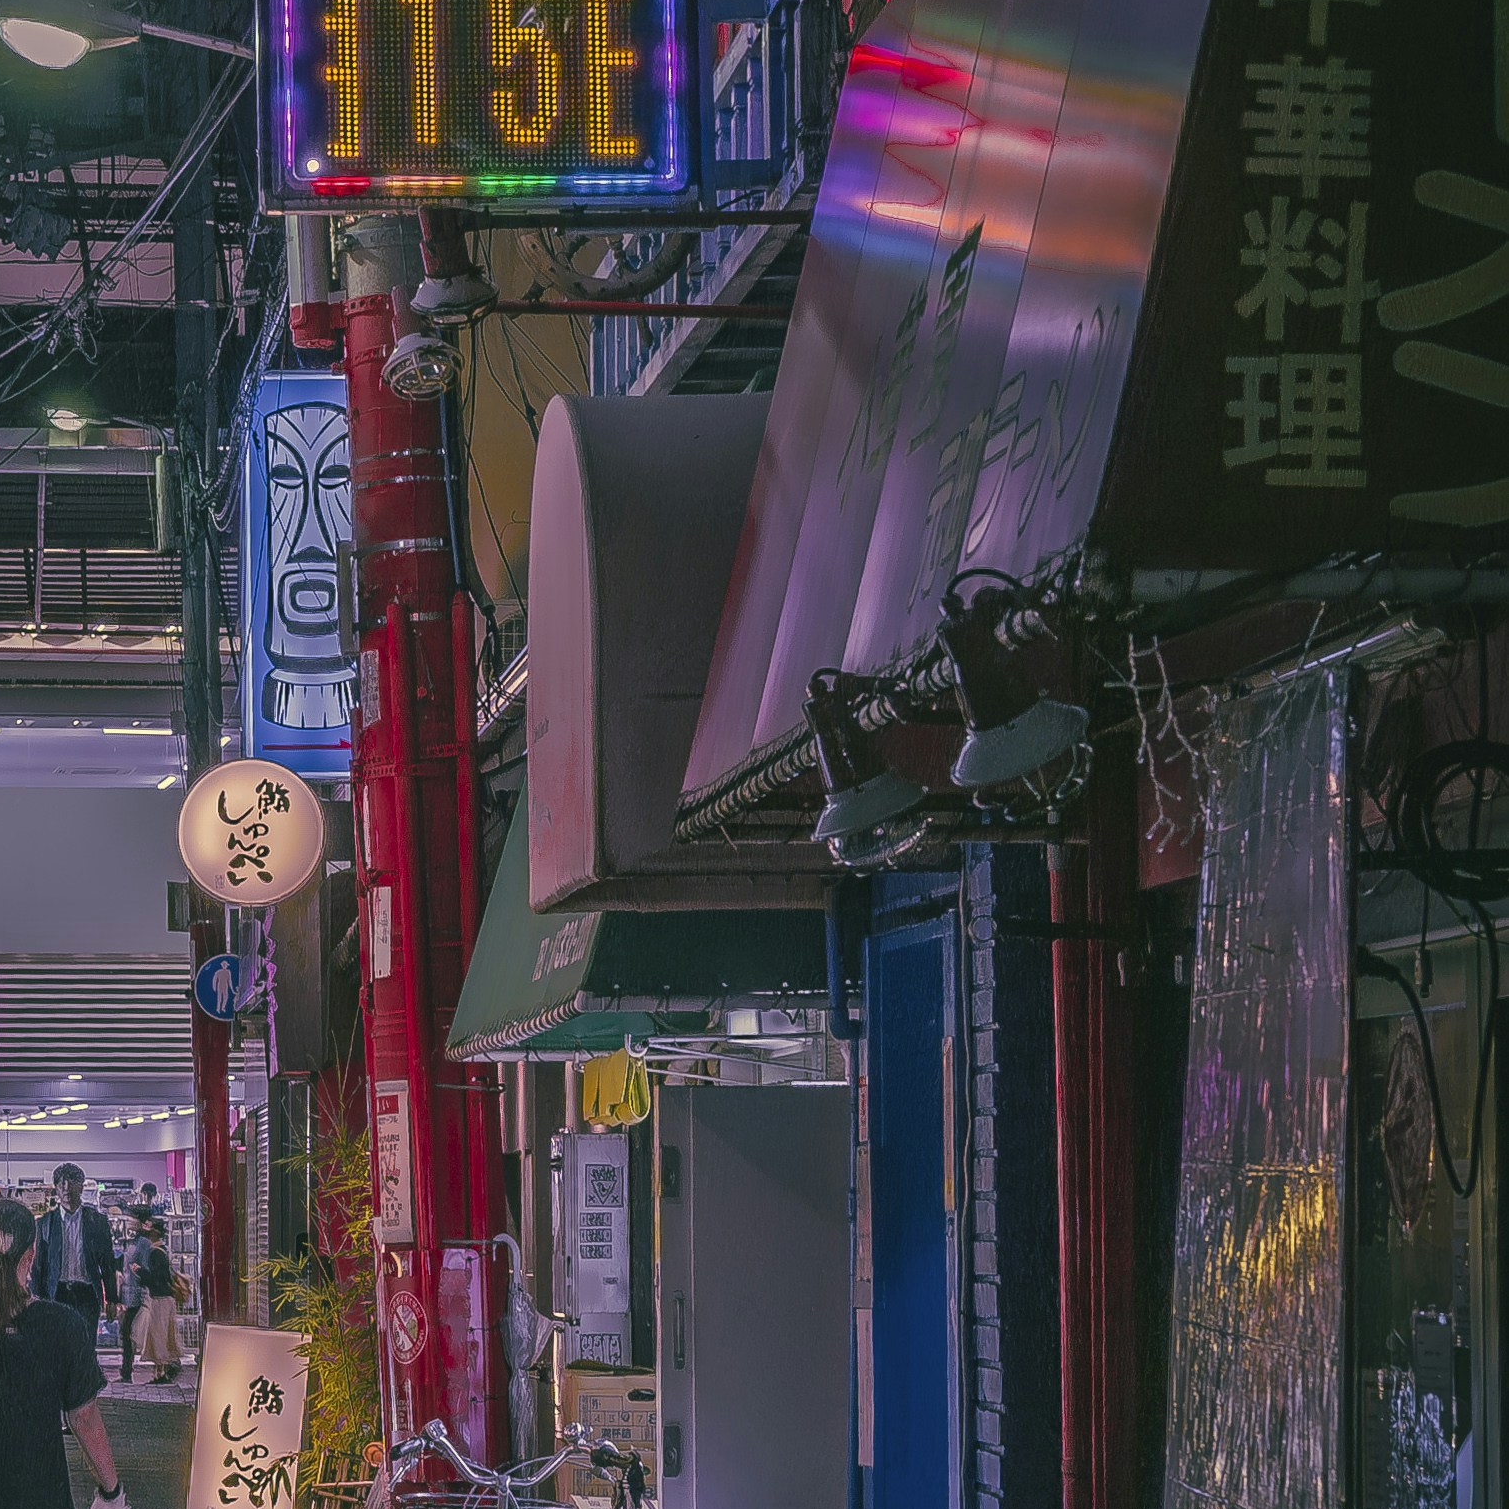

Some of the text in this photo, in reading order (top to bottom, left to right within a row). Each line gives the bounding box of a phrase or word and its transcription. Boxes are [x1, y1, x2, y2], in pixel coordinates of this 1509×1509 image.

[217, 790, 274, 886] しゅんぺい
